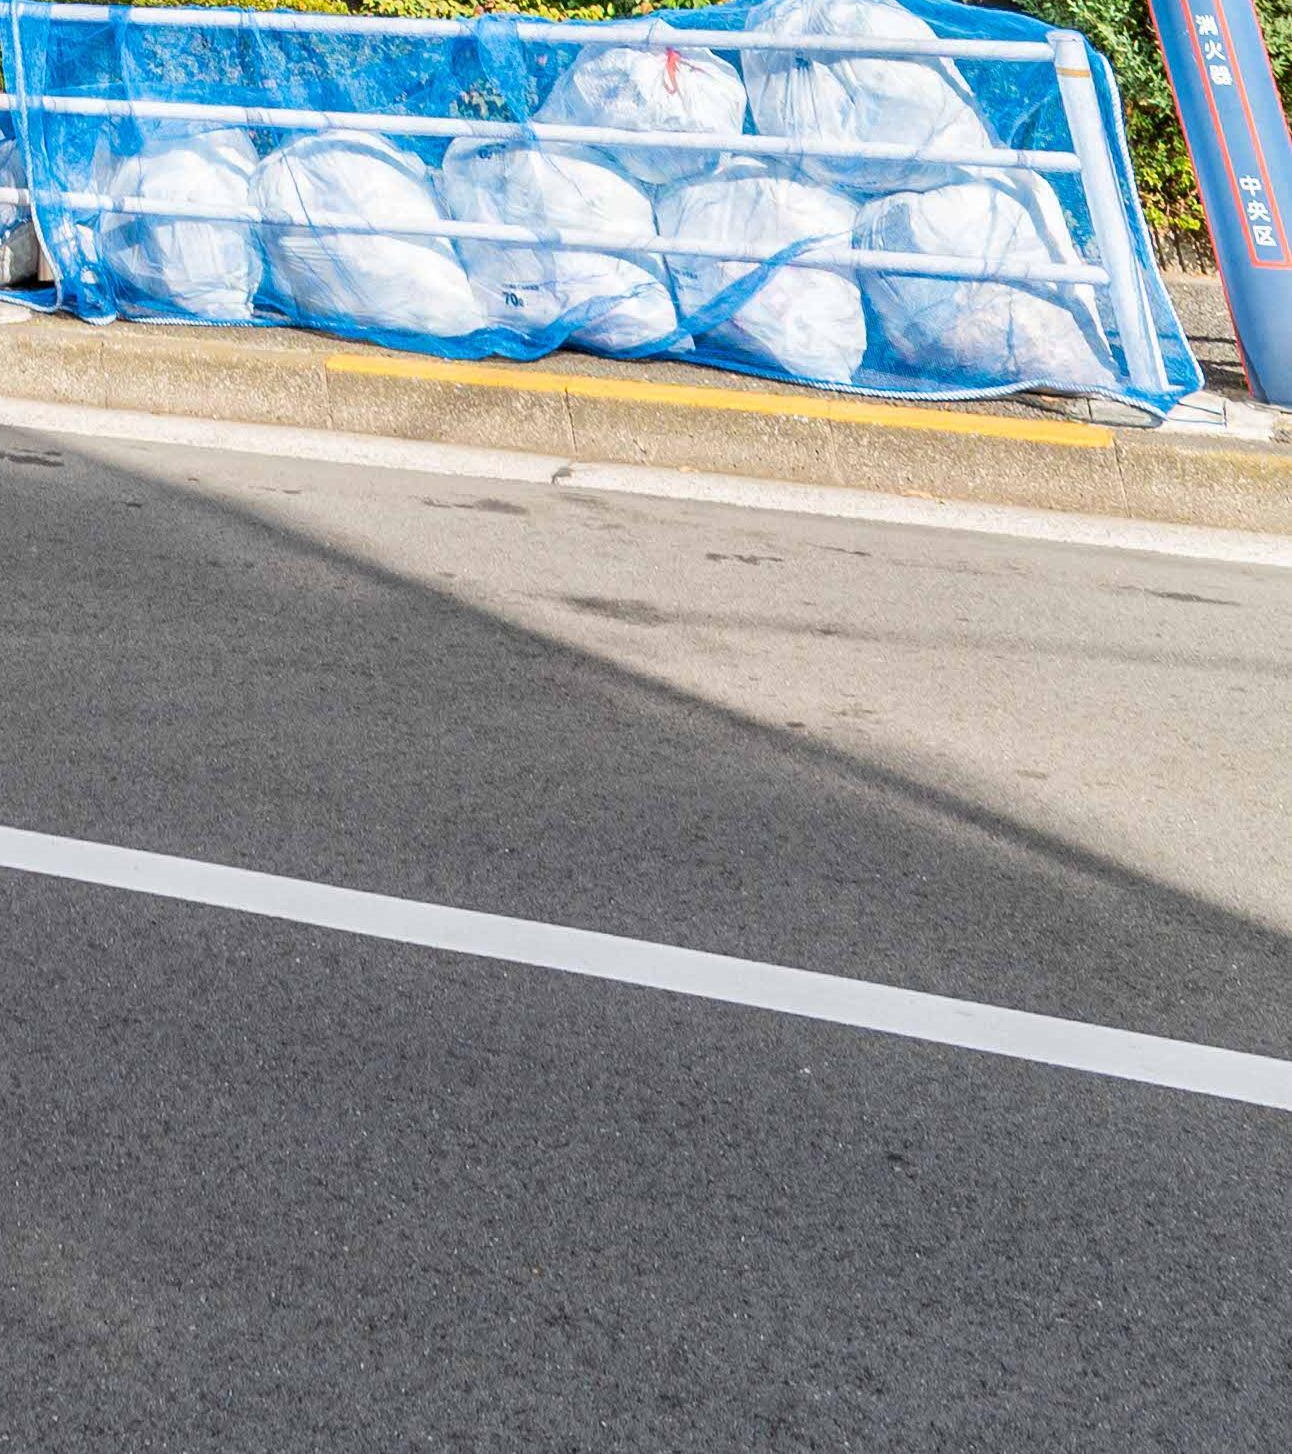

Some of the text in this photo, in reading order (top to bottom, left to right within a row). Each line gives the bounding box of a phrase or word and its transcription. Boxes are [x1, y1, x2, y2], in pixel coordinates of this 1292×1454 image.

[1195, 14, 1233, 87] 消火器
[1239, 175, 1277, 247] 中央区
